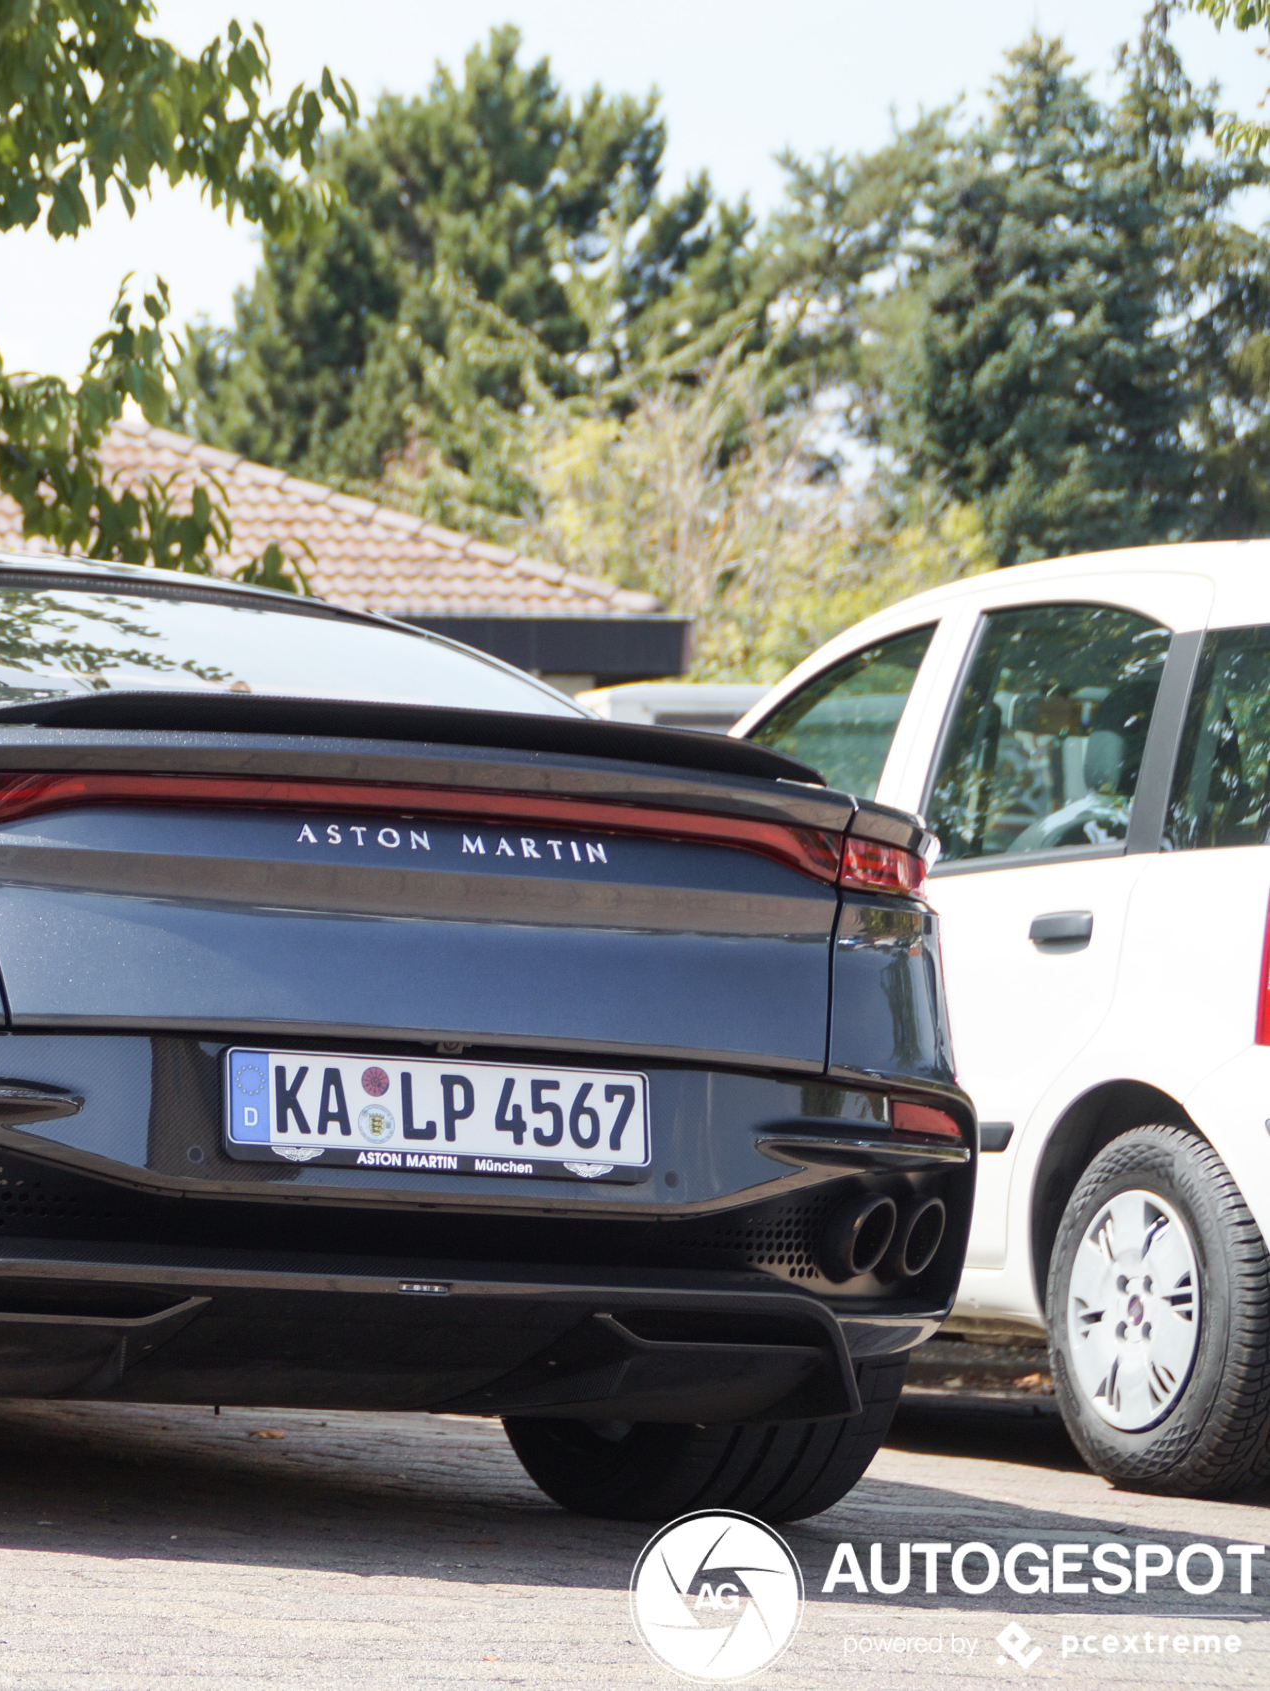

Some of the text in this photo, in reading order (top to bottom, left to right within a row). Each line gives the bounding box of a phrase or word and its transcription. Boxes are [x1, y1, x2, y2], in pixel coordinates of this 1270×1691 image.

[296, 823, 608, 864] ASTON MARTIN
[243, 1107, 259, 1127] D
[274, 1065, 352, 1137] KA
[400, 1071, 475, 1142] LP
[494, 1077, 636, 1151] 4567
[356, 1151, 533, 1174] ASTON MARTIN München
[1177, 1171, 1220, 1263] UNIROYA
